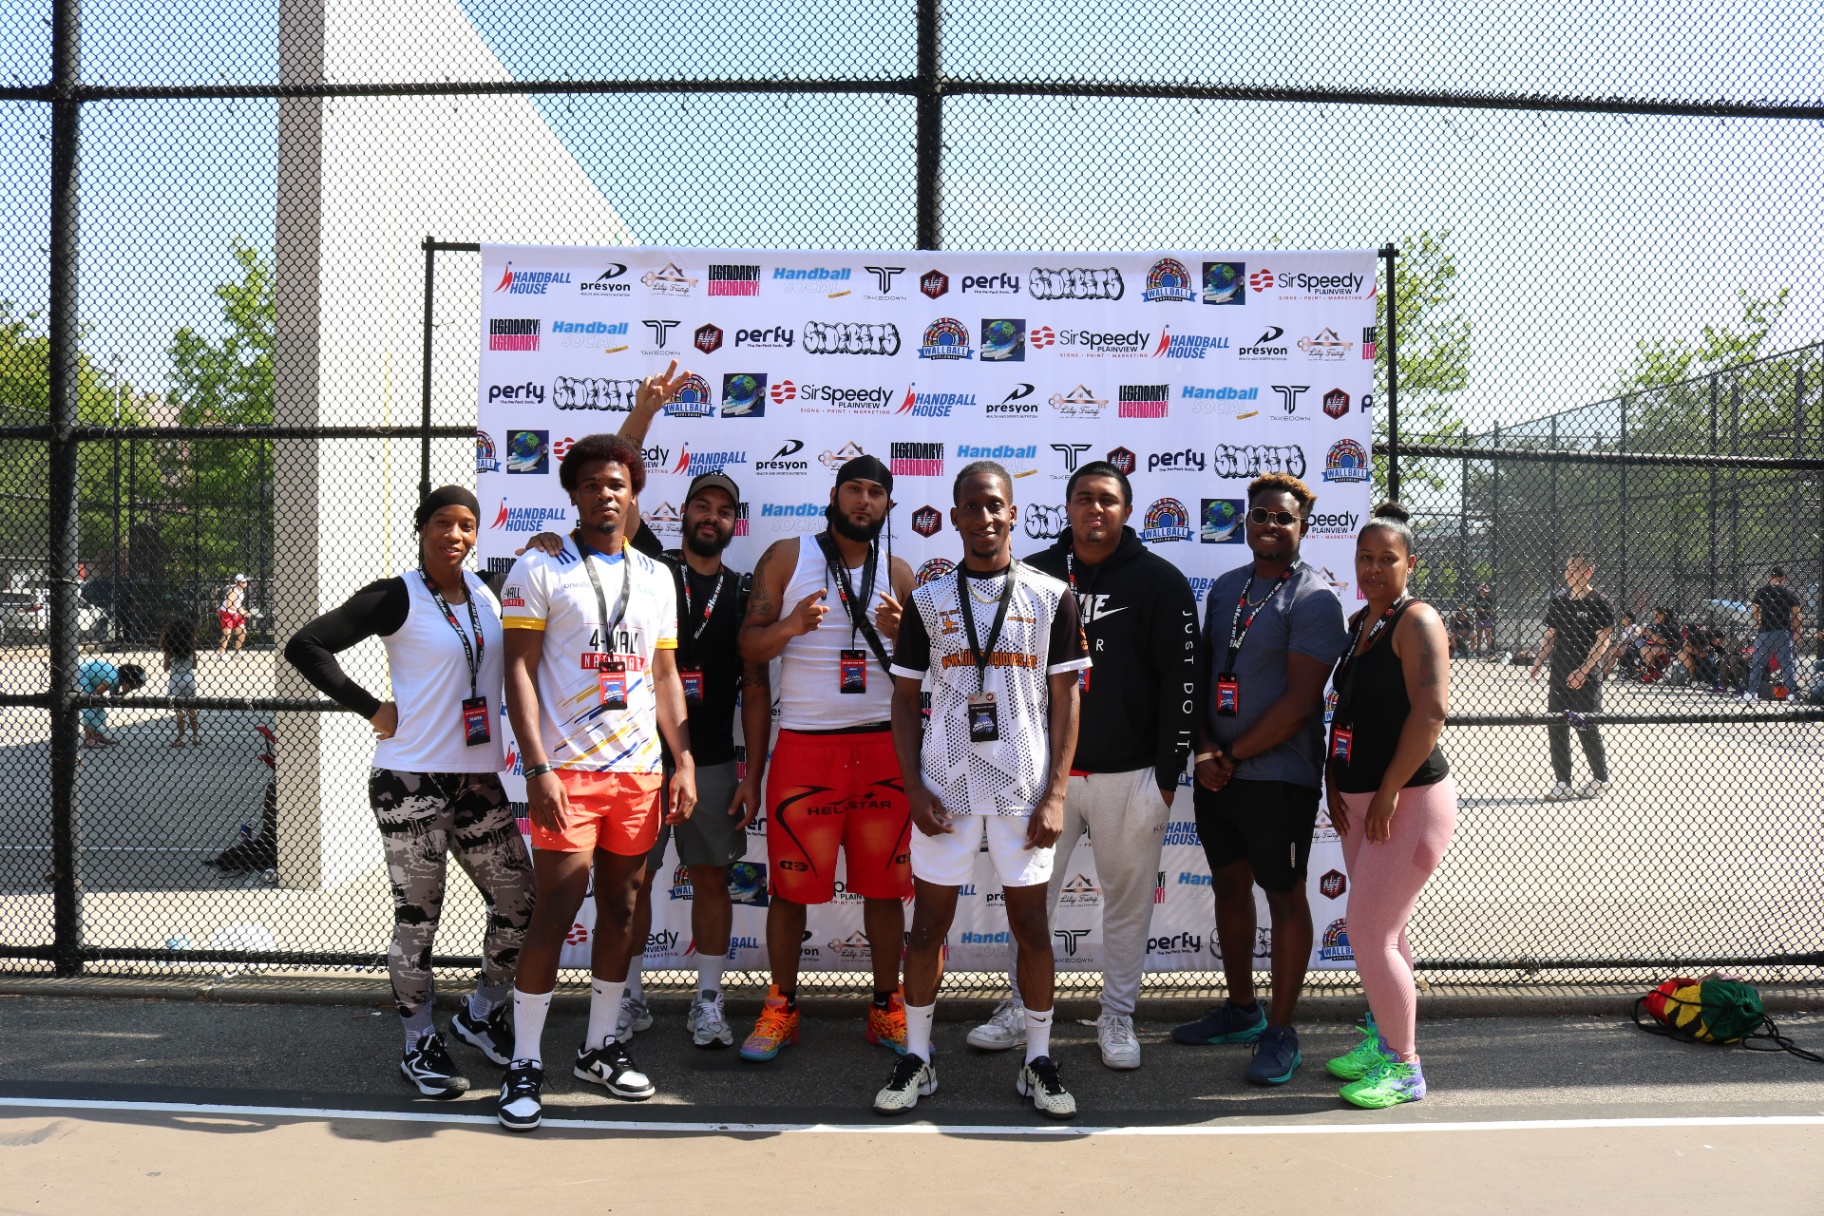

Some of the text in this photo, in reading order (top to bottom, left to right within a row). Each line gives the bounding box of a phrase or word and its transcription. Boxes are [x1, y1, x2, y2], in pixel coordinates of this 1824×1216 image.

[513, 272, 571, 284] HANDBALL
[708, 265, 758, 280] LEGENDARY
[773, 267, 851, 280] Handball
[510, 283, 548, 294] HOUSE
[580, 282, 630, 292] presyon
[708, 281, 757, 296] LEGENDARY
[784, 280, 838, 293] SOCIAL
[962, 272, 1019, 294] perfy
[1148, 288, 1190, 298] WALLBALL
[490, 319, 538, 335] LEGENDARY
[552, 321, 628, 335] Handball
[489, 335, 538, 351] LEGENDARY
[562, 334, 618, 348] SOCIAL
[735, 326, 794, 347] perfy
[1170, 335, 1230, 348] HANDBALL
[923, 347, 966, 356] WALLBALL
[1167, 347, 1206, 359] HOUSE
[1239, 347, 1288, 356] presyon
[488, 382, 545, 404] perfy
[915, 392, 976, 406] HANDBALL
[1119, 385, 1166, 401] LEGENDARY
[1182, 386, 1258, 400] Handball
[668, 404, 709, 413] WALLBALL
[912, 405, 952, 417] HOUSE
[986, 404, 1038, 413] presyon
[1118, 402, 1166, 418] LEGENDARY
[1192, 400, 1248, 414] SOCIAL
[891, 442, 940, 459] LEGENDARY
[957, 445, 1037, 459] Handball
[477, 460, 493, 468] BALL
[690, 451, 747, 465] HANDBALL
[1148, 449, 1205, 472] perfy
[756, 461, 807, 470] presyon
[890, 459, 940, 476] LEGENDARY
[1327, 468, 1366, 478] WALLBALL
[507, 508, 566, 520] HANDBALL
[761, 503, 828, 517] Handba
[505, 520, 543, 531] HOUSE
[1307, 511, 1359, 531] peedy
[1146, 527, 1187, 538] WALLBALL
[504, 587, 521, 598] -WALL
[1182, 611, 1194, 664] JUST
[1183, 683, 1194, 714] DO
[1166, 822, 1197, 834] HAND
[1163, 833, 1201, 846] HOUSE
[729, 937, 758, 948] BALL
[961, 931, 1009, 944] Hand
[1147, 932, 1201, 954] perfy
